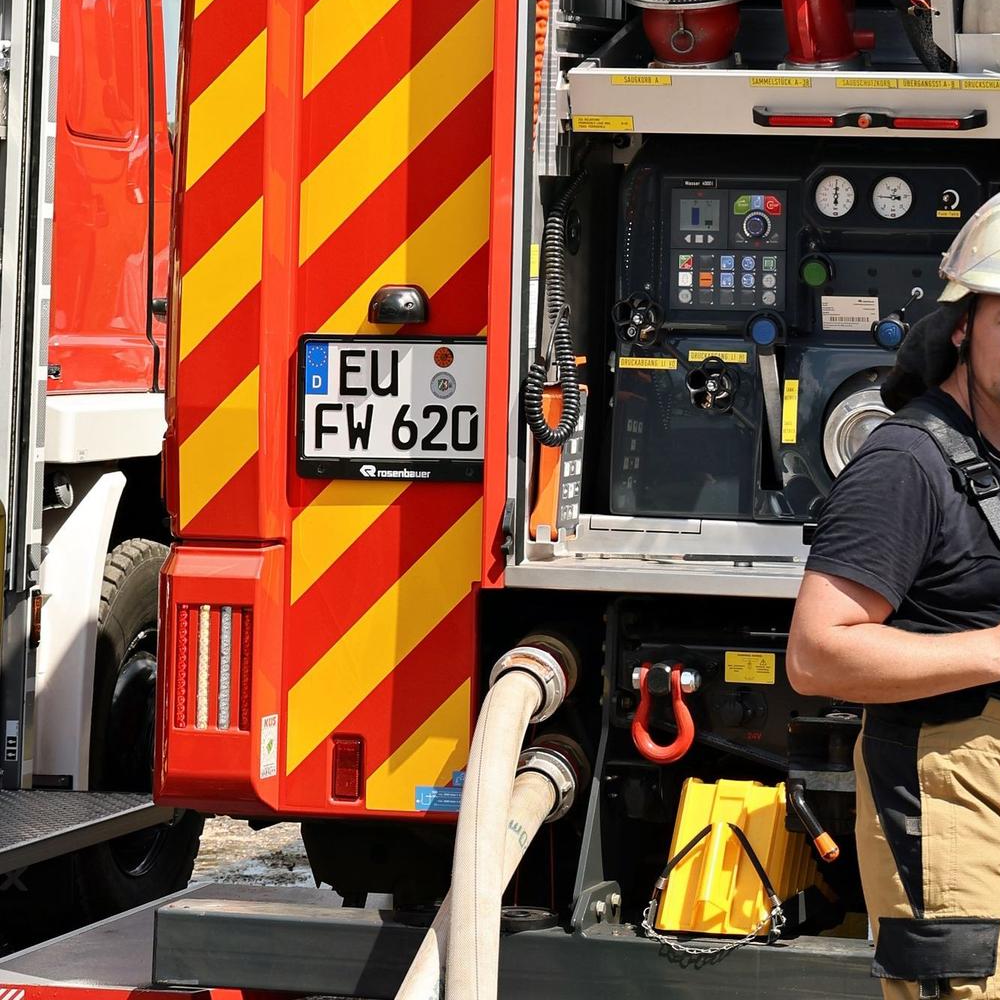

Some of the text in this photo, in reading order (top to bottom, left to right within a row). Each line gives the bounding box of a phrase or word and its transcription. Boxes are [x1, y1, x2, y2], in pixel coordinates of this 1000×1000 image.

[312, 375, 322, 389] D
[339, 349, 399, 397] EU
[314, 403, 479, 452] FW 620
[377, 466, 431, 478] rosenbauer
